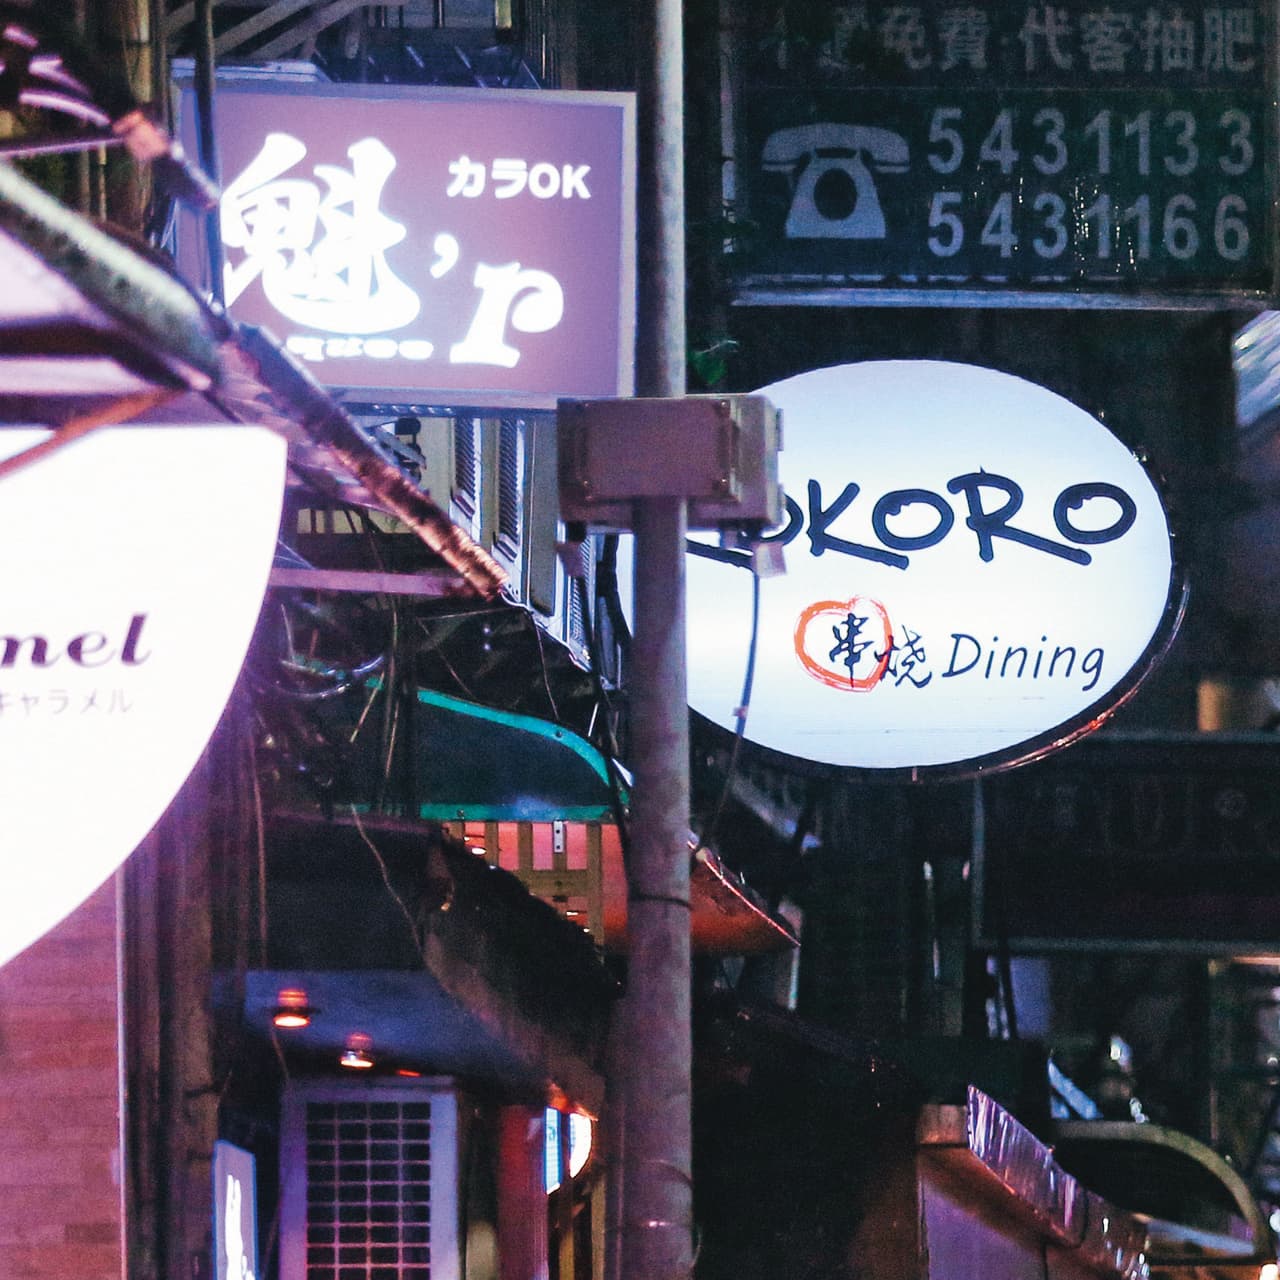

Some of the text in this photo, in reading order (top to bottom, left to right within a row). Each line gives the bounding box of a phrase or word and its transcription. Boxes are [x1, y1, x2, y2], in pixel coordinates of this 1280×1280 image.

[758, 6, 1256, 72] 免費 代客抽肥
[686, 466, 1138, 571] KORO
[941, 632, 1106, 692] Dining
